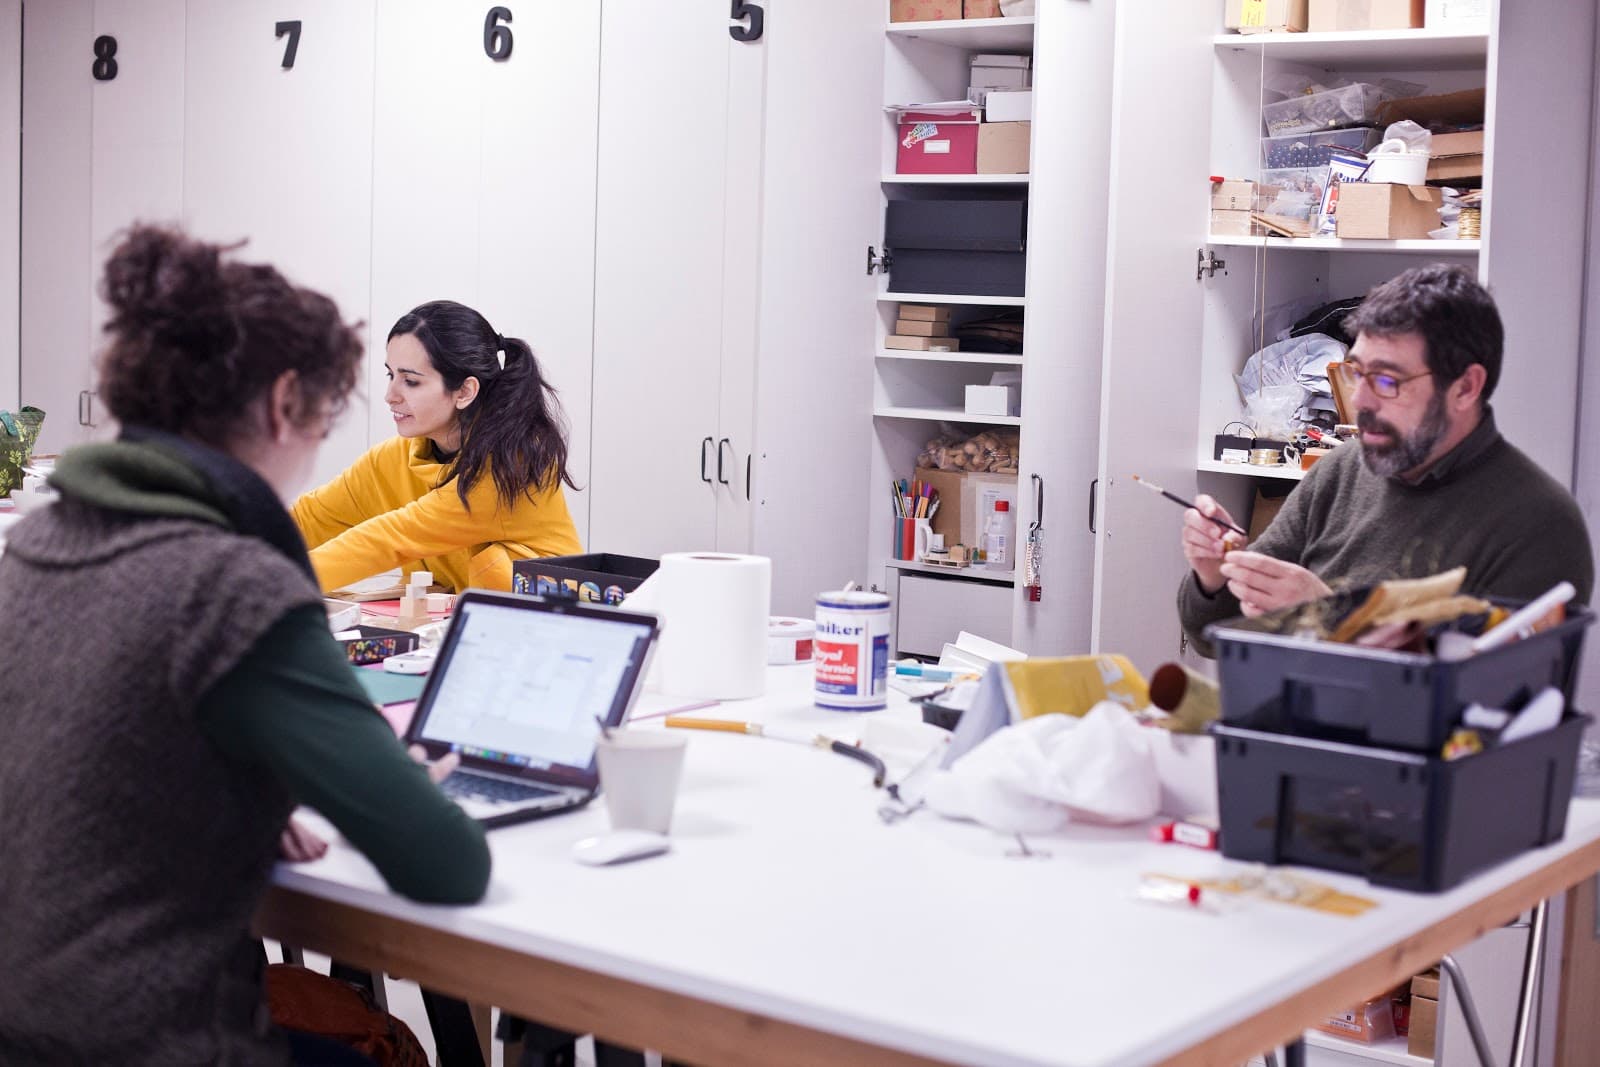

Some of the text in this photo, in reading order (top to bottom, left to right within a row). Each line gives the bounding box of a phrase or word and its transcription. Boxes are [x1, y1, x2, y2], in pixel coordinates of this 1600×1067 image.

[275, 20, 302, 68] 7
[484, 6, 514, 61] 6
[729, 0, 764, 42] 5
[92, 35, 118, 81] 8
